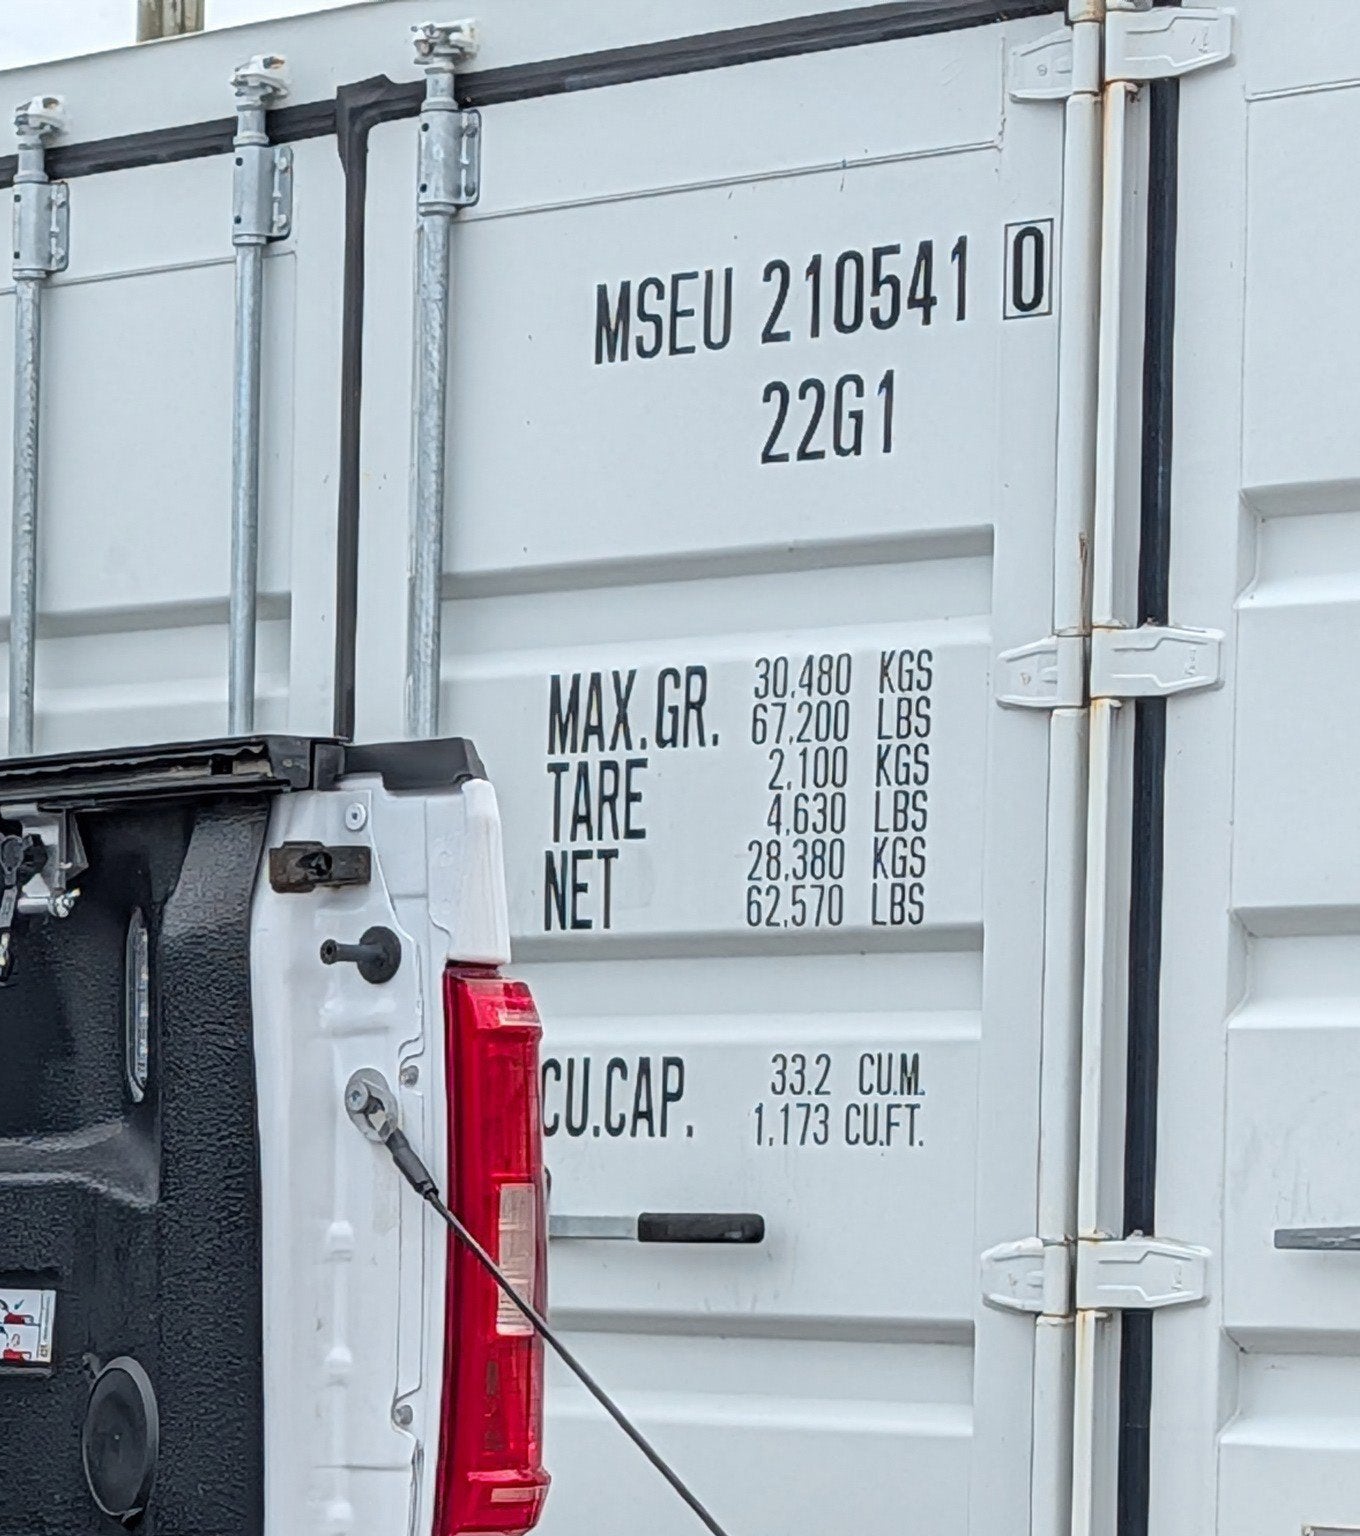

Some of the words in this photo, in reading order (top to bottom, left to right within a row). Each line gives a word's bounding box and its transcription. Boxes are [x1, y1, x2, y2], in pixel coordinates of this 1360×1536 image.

[594, 266, 733, 365] MSEU
[761, 234, 968, 345] 210541
[1012, 226, 1045, 313] 0
[760, 368, 895, 465] 22G1
[547, 665, 720, 756] MAX.GR.
[878, 648, 933, 695] KGS
[877, 695, 932, 741] LBS
[546, 757, 649, 844] TARE
[875, 742, 930, 788] KGS
[874, 789, 928, 833] LBS
[543, 847, 620, 932] NET
[872, 835, 927, 880] KGS
[871, 881, 925, 927] LBS
[770, 1053, 832, 1096] 33.2
